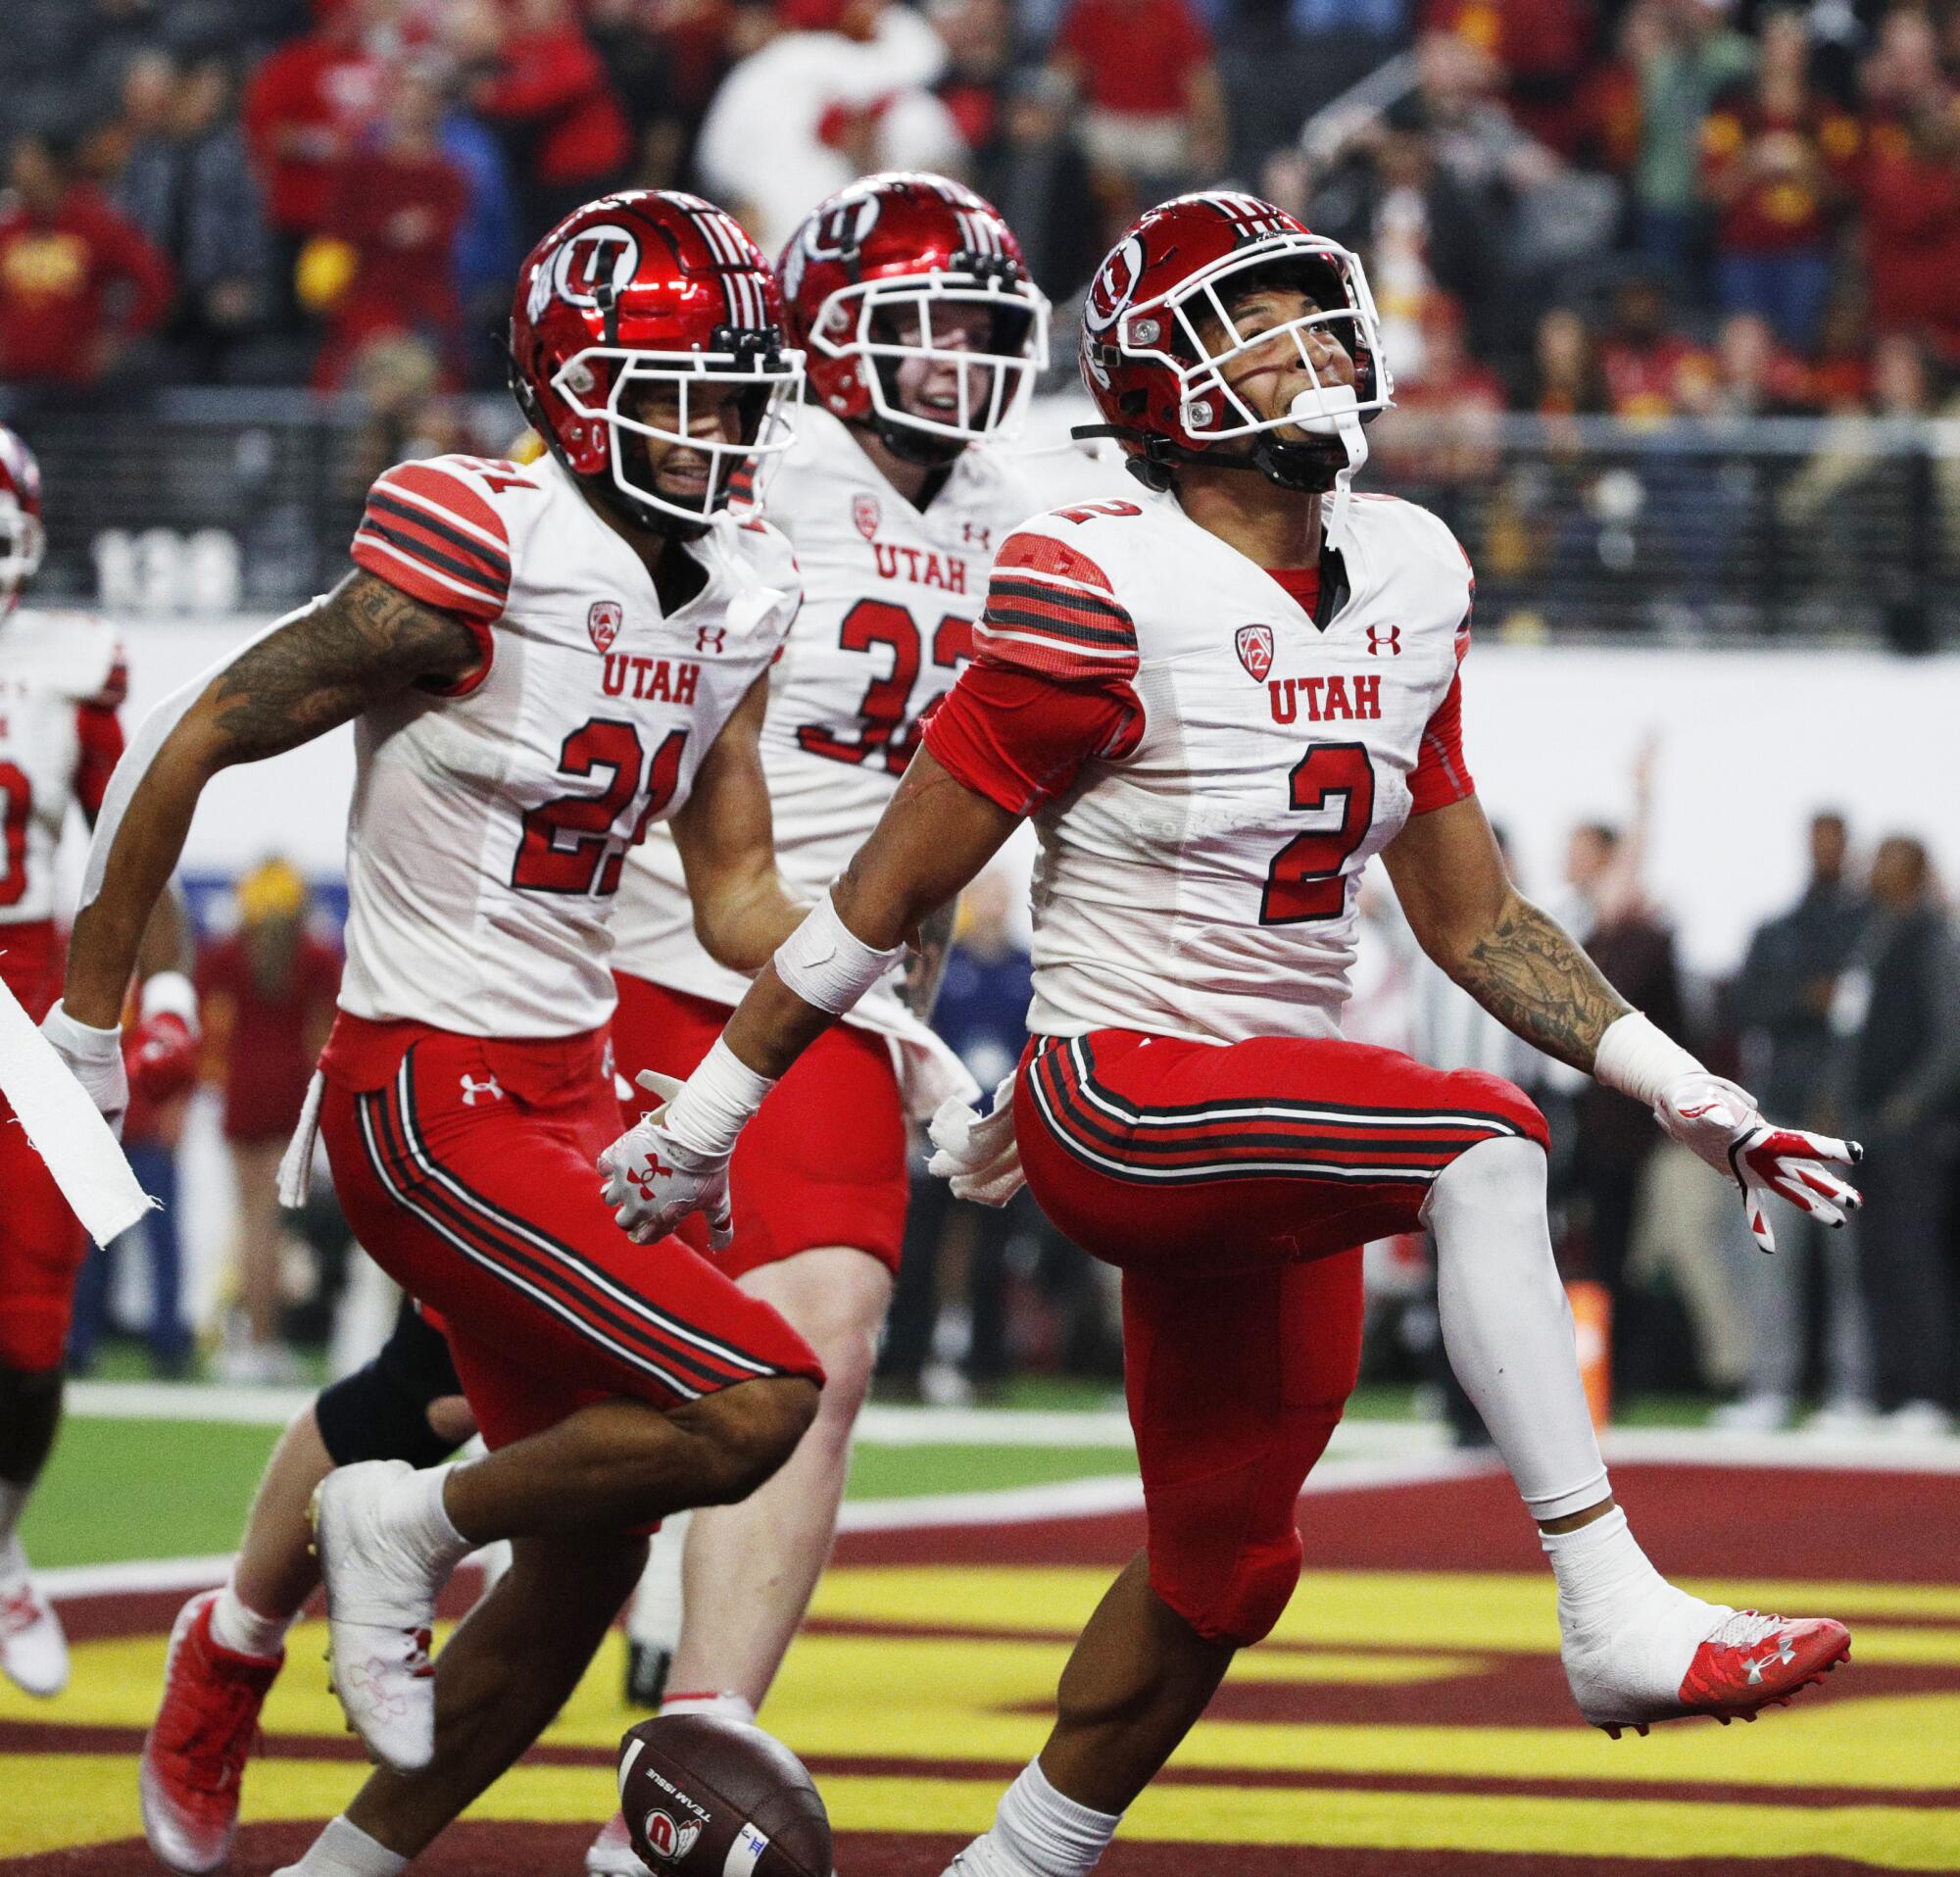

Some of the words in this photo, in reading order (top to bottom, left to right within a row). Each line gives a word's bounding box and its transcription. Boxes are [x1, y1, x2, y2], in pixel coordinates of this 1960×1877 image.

[874, 543, 966, 595] UTAH
[602, 654, 700, 705] UTAH
[1247, 649, 1268, 670] 12
[1268, 675, 1381, 724] UTAH
[511, 716, 690, 896] 21
[1258, 741, 1375, 925] 2
[645, 1767, 676, 1795] ISSUE
[675, 1791, 712, 1822] TEAM
[649, 1815, 672, 1854] U
